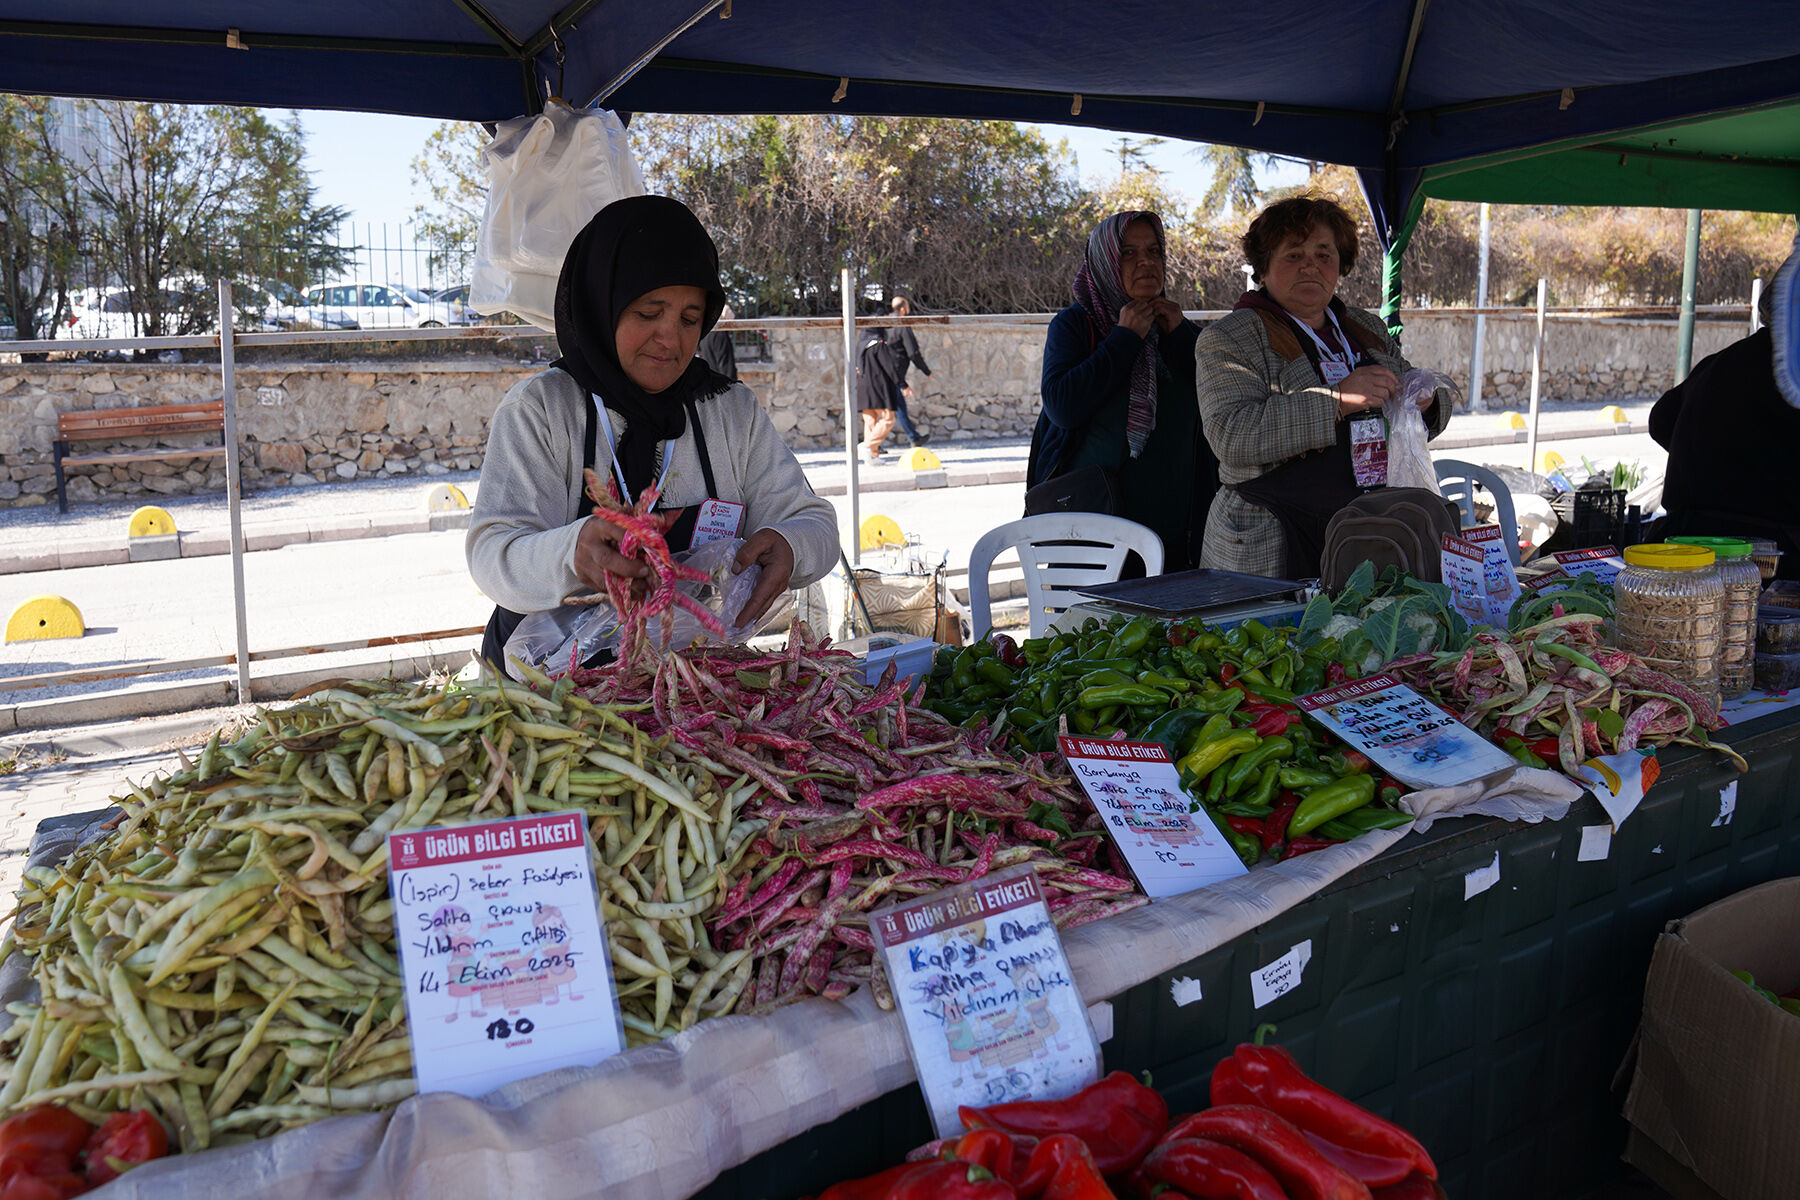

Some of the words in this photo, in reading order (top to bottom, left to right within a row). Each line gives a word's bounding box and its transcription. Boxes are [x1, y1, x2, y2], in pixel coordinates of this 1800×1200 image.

[1311, 691, 1339, 704] ÜRÜN
[1337, 684, 1363, 698] BİLGİ
[1361, 675, 1395, 691] ETİKETİ
[1078, 741, 1107, 756] ÜRÜN
[1106, 743, 1132, 758] BİLGİ
[1131, 745, 1166, 759] ETİKETİ
[1078, 763, 1142, 782] Barbunya
[1161, 819, 1189, 828] 2025
[425, 833, 470, 859] ÜRÜN
[474, 826, 516, 853] BİLGİ
[520, 819, 577, 847] ETİKETİ
[904, 904, 946, 933] ÜRÜN
[946, 891, 985, 921] BİLGİ
[984, 876, 1036, 910] ETİKETİ
[459, 961, 512, 984] Ekim
[528, 952, 584, 972] 2025
